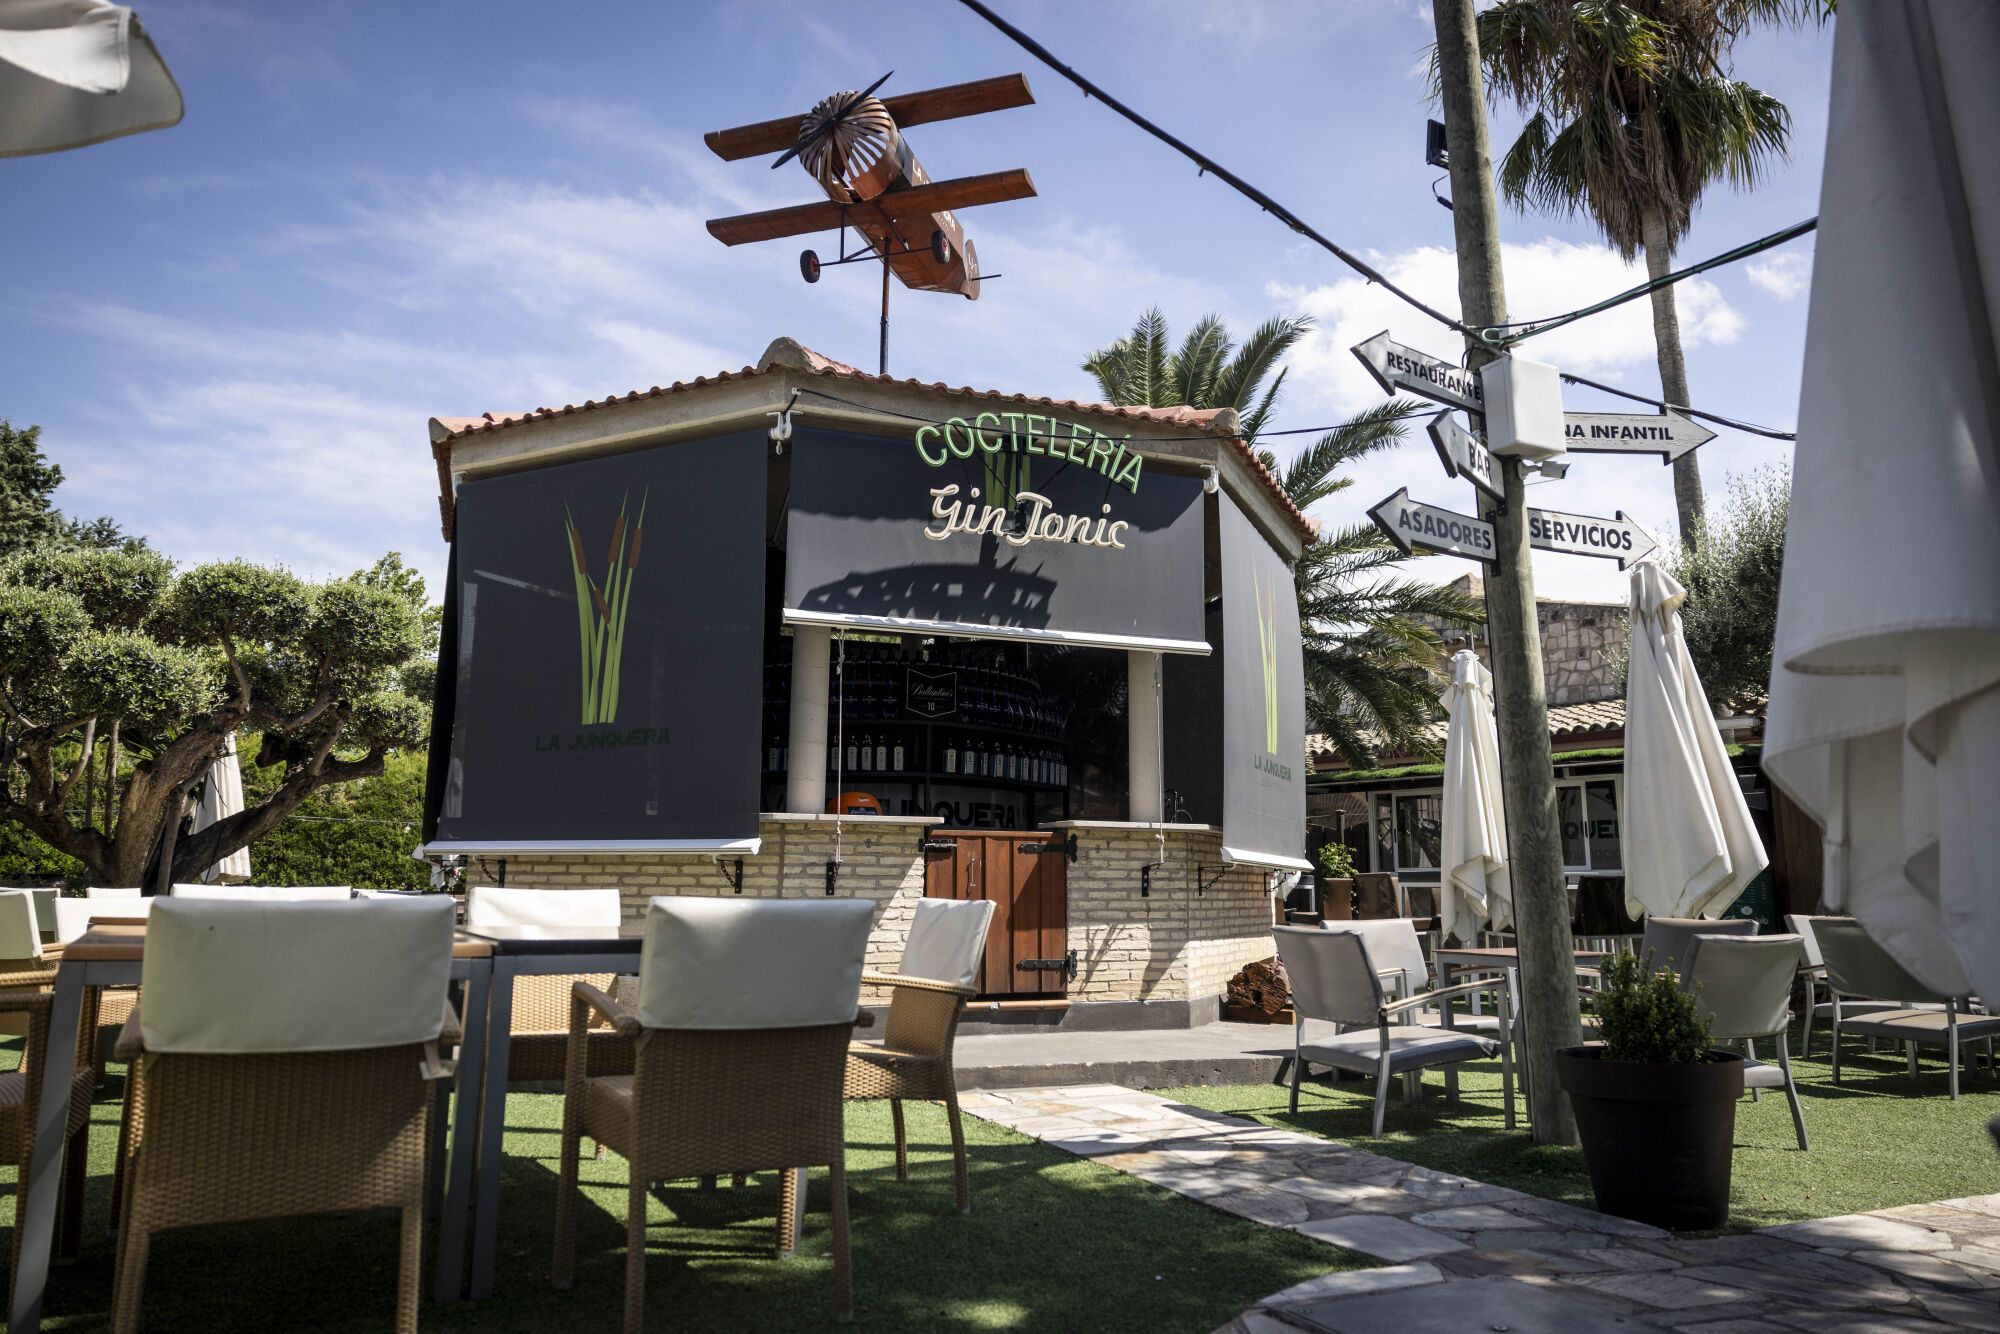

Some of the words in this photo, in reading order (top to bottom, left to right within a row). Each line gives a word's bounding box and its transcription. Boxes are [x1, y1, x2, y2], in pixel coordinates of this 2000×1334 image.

[1386, 350, 1481, 400] RESTAURANTE
[915, 412, 1144, 495] COCTELERÍA
[1591, 425, 1674, 440] INFANTIL
[1468, 440, 1492, 483] BAR
[924, 484, 1006, 541] Gin
[1005, 491, 1129, 549] Tonic
[1399, 508, 1492, 550] ASADORES
[1529, 517, 1633, 550] SERVICIOS
[927, 702, 935, 711] 10
[535, 734, 560, 752] LA
[568, 728, 670, 750] JUNQUERA
